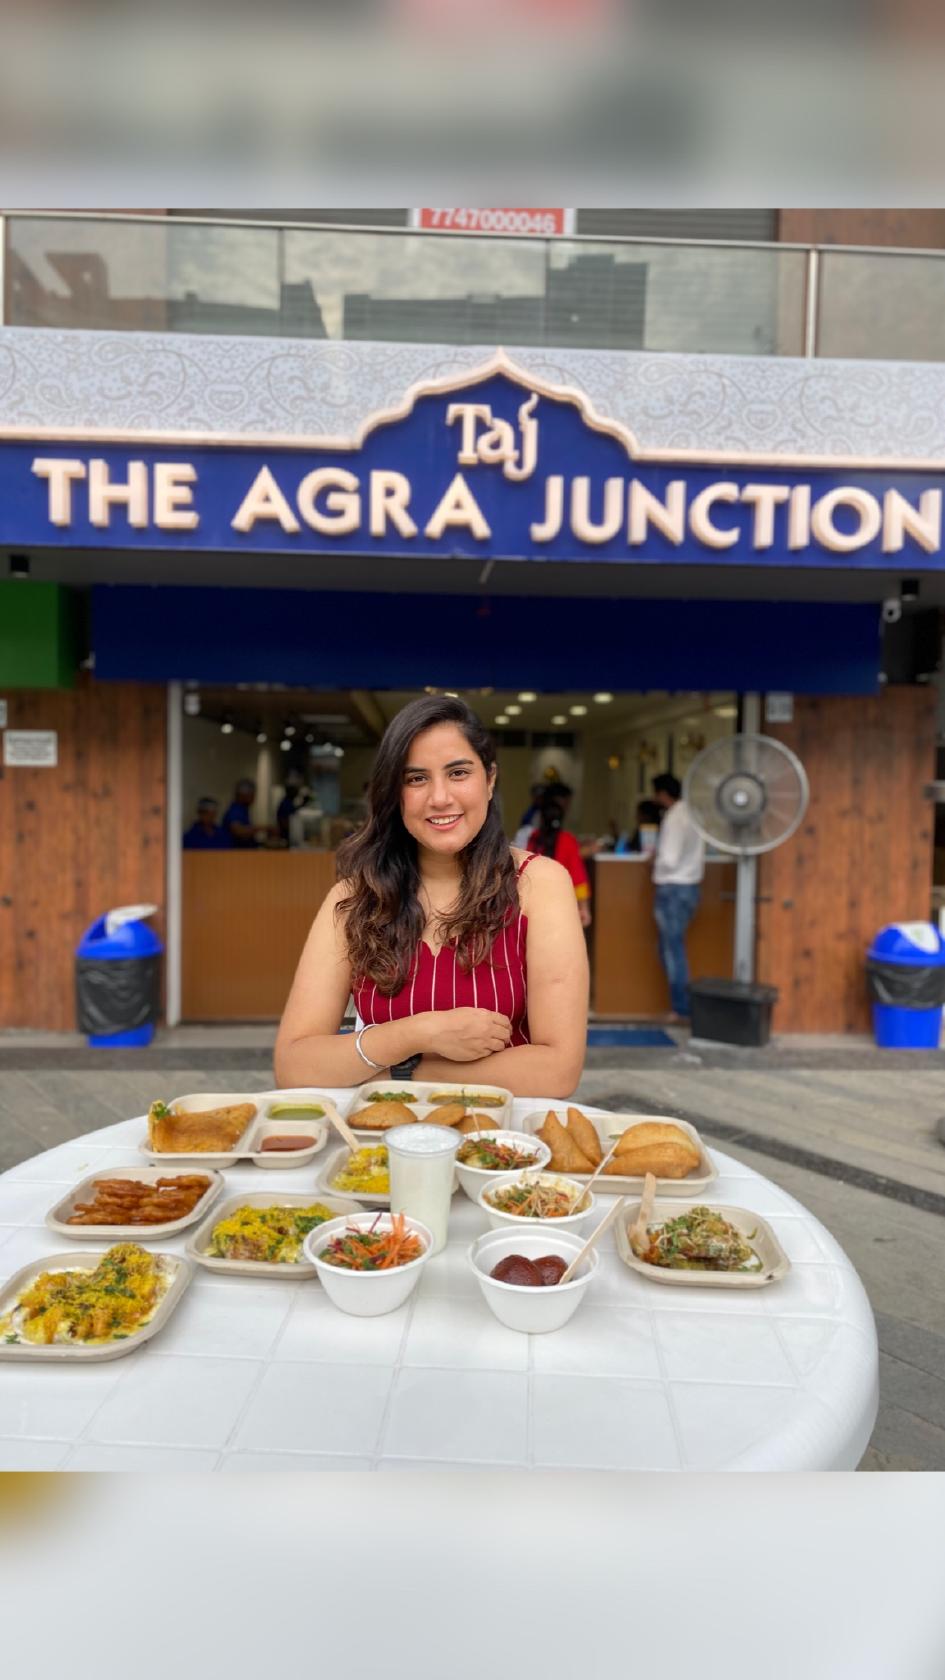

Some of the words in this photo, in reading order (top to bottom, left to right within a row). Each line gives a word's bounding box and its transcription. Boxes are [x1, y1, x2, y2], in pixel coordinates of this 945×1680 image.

[430, 208, 556, 234] 7747000046
[446, 392, 539, 482] Taj
[31, 457, 200, 529] THE
[230, 464, 492, 540] AGRA
[530, 475, 942, 553] JUNCTION
